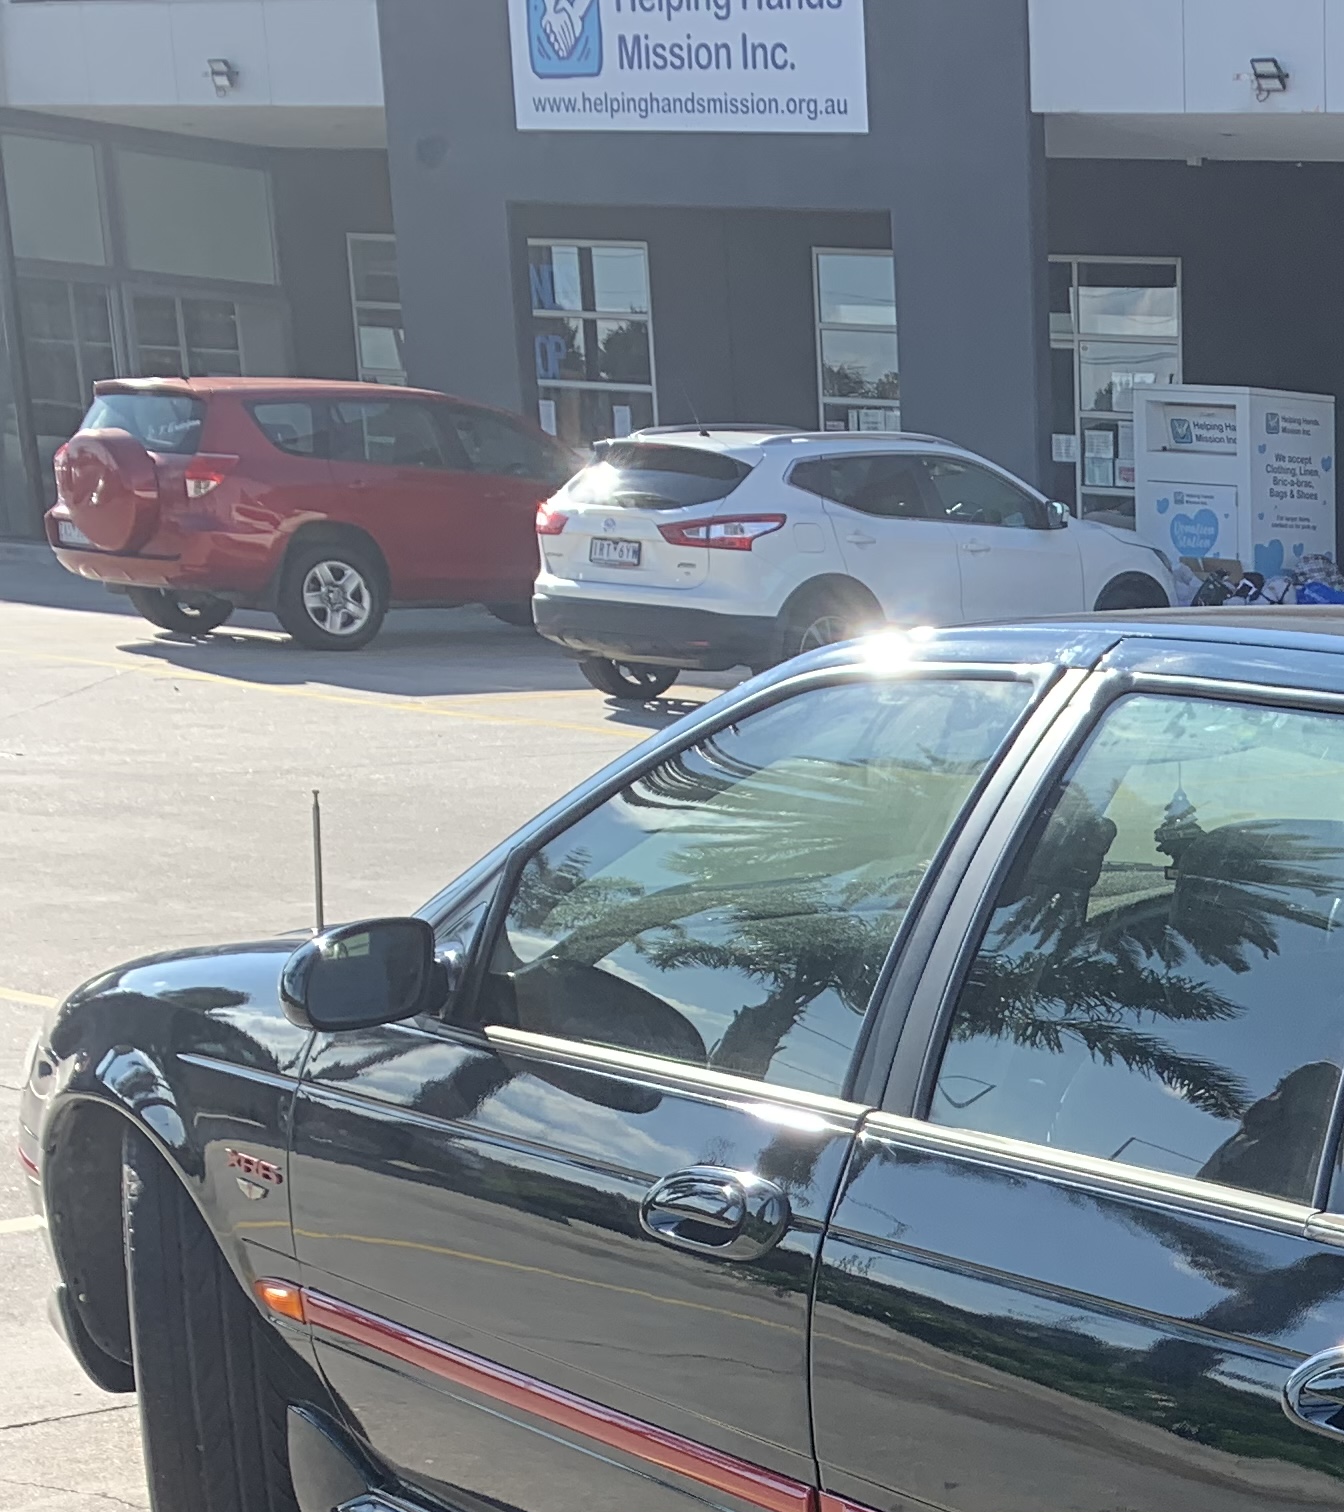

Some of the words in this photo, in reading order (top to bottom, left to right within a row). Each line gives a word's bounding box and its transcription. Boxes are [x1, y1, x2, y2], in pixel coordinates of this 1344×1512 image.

[618, 33, 732, 72] Mission
[741, 32, 796, 72] Inc.
[532, 91, 849, 121] www.helpinghandsmission.org.au
[1192, 421, 1225, 434] Helping
[1195, 434, 1225, 444] Mission
[1274, 453, 1287, 463] We
[224, 1147, 284, 1185] XR6
